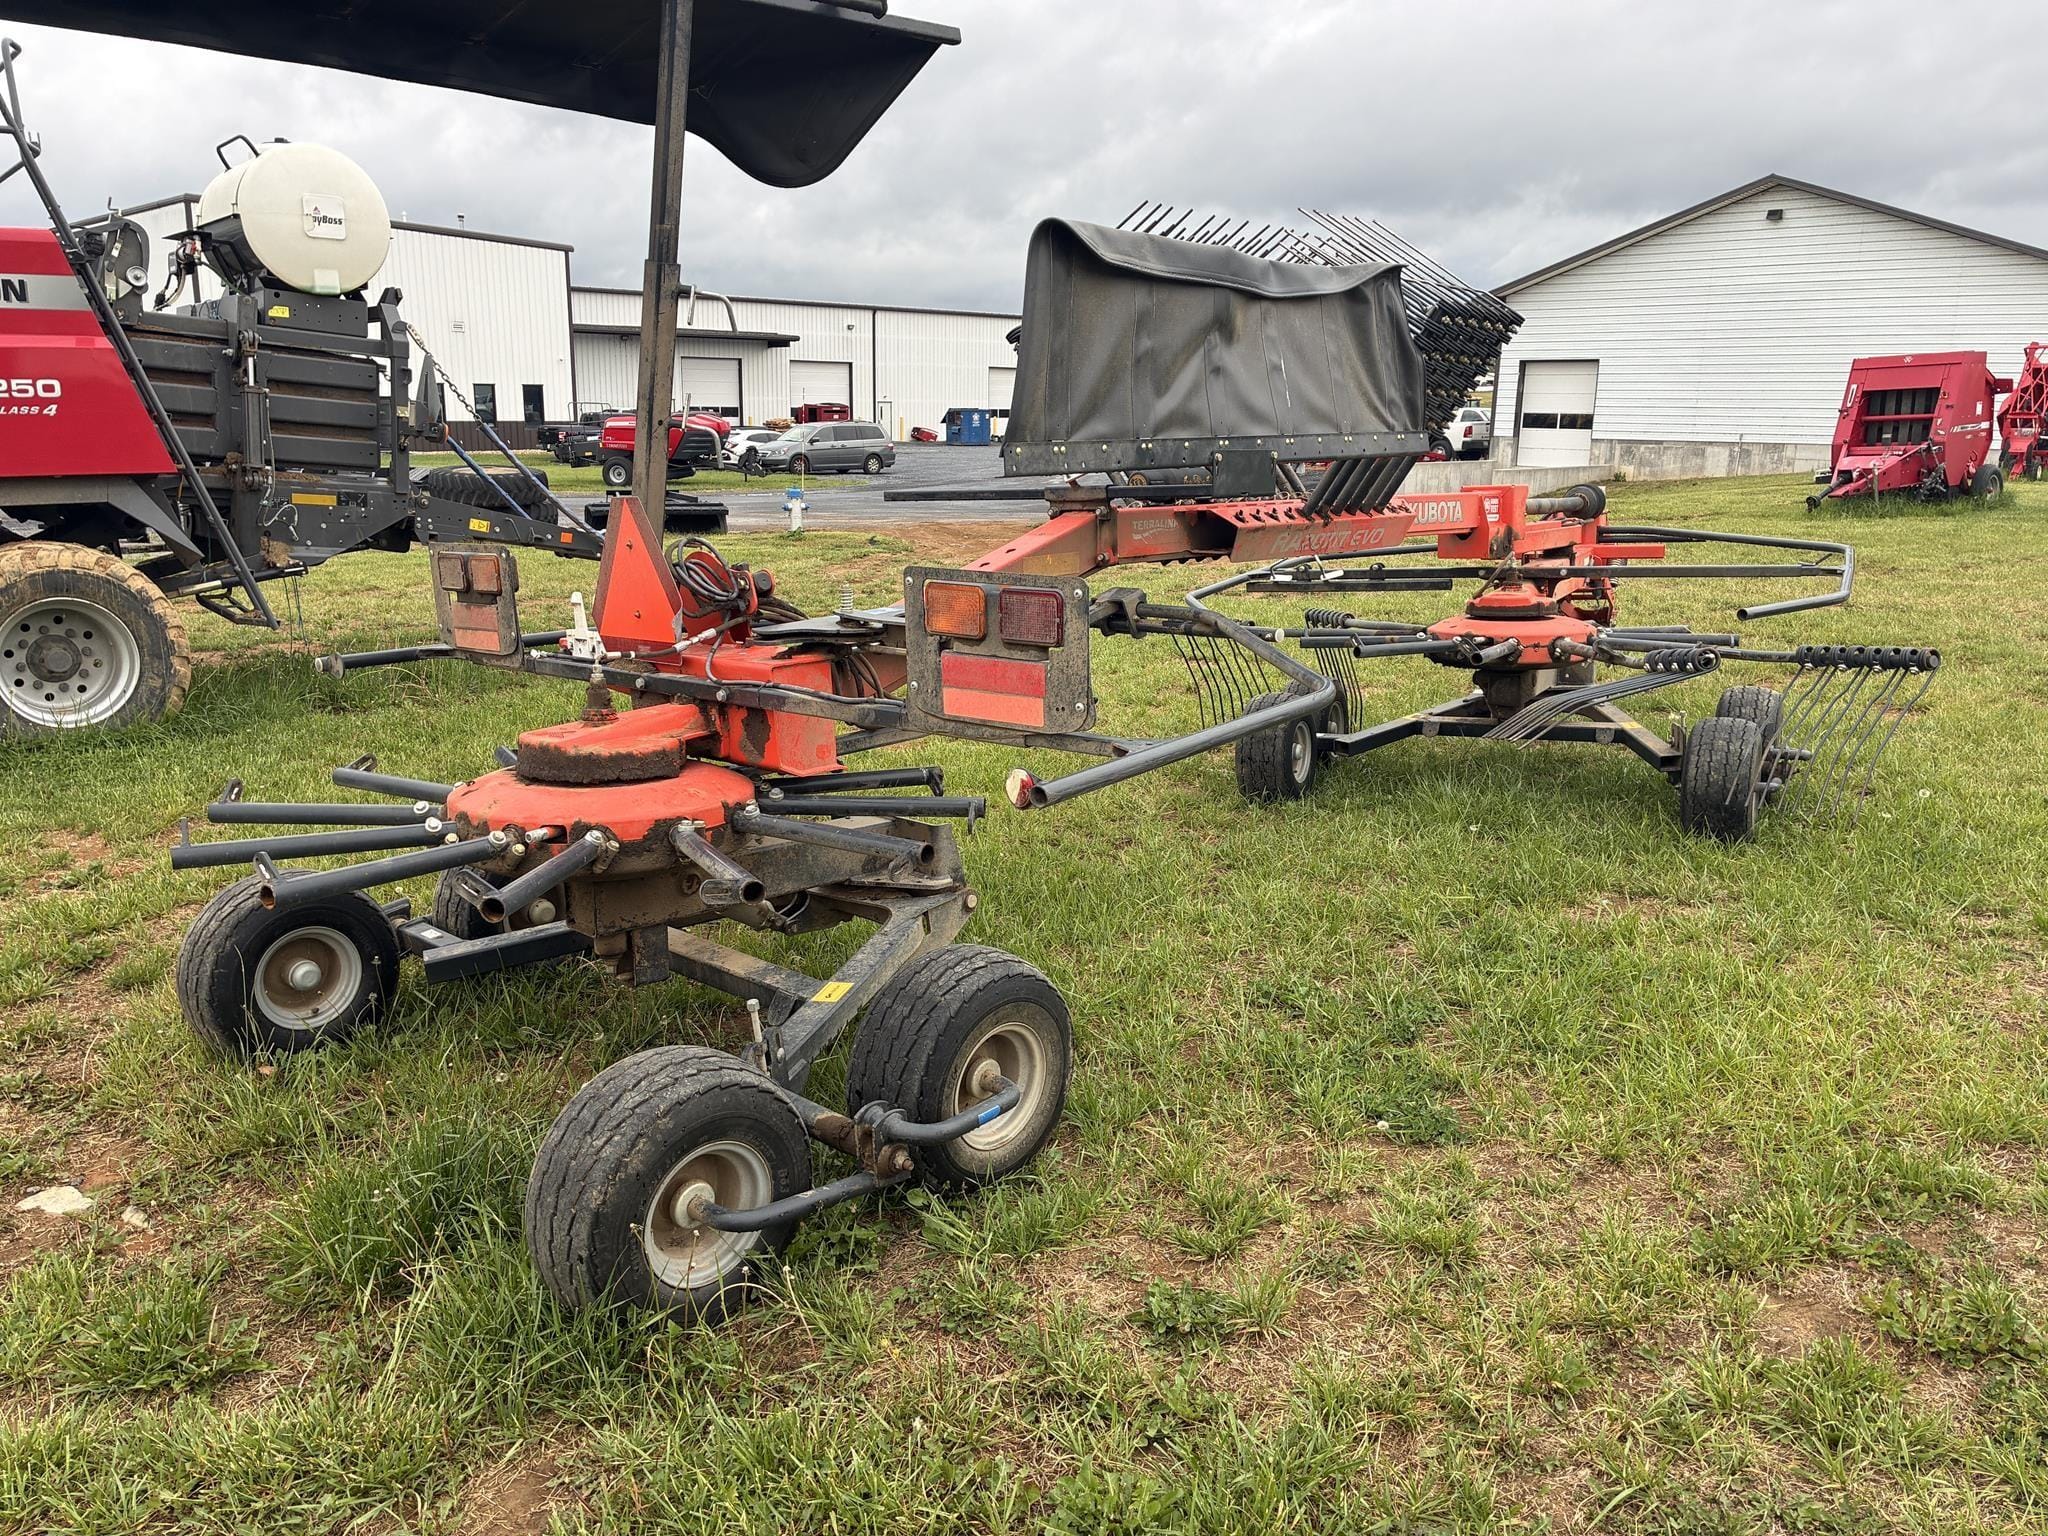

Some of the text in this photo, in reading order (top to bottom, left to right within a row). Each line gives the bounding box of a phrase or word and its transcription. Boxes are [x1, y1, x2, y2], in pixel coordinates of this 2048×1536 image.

[0, 278, 30, 303] N
[42, 403, 58, 417] 4
[1408, 500, 1464, 524] KUBOTA
[1350, 527, 1385, 545] EVO
